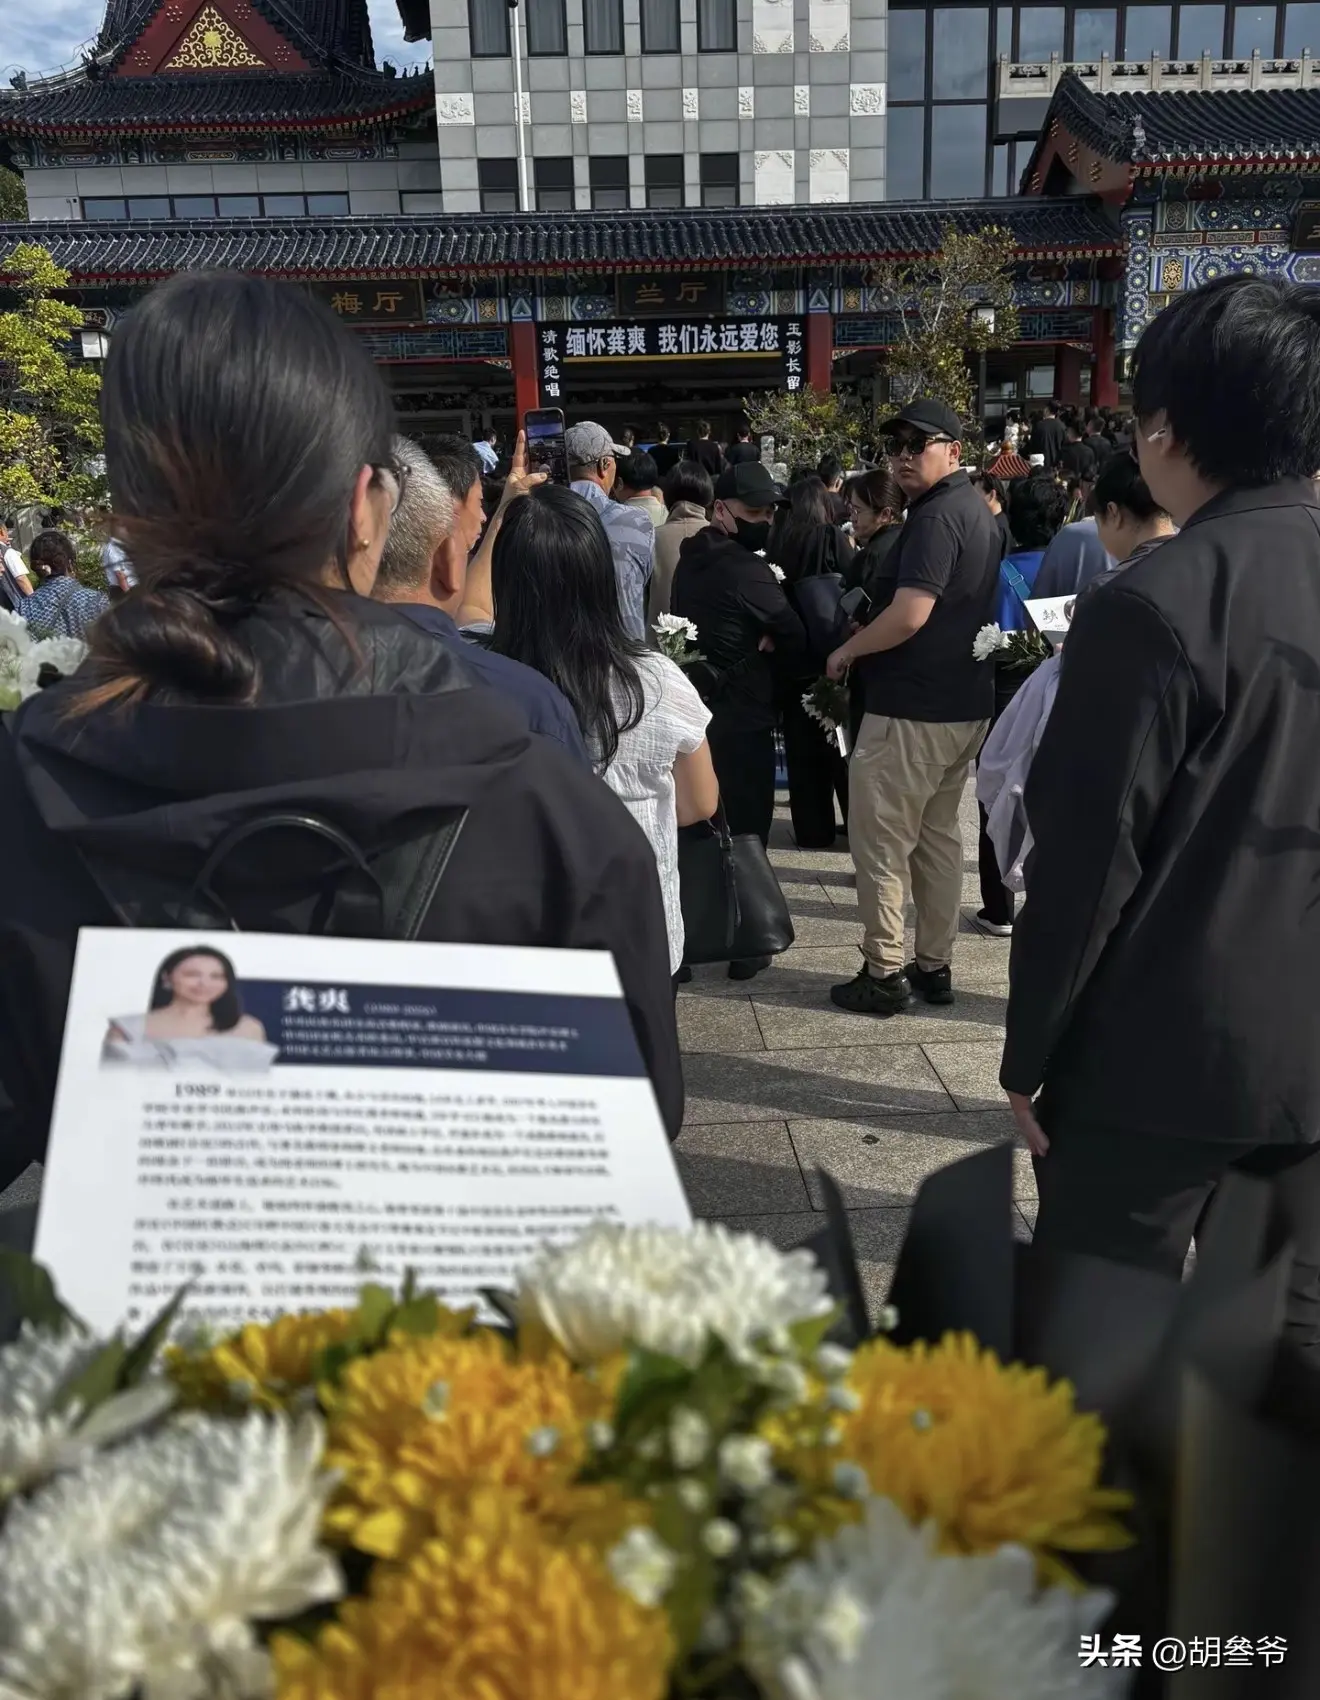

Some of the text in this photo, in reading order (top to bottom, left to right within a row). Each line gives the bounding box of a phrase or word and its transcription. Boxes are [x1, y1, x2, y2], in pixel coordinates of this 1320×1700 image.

[331, 291, 404, 315] 梅厅
[635, 282, 707, 303] 兰厅
[566, 322, 780, 357] 缅怀龚爽 我们永远爱您
[785, 322, 803, 390] 玉影长留
[542, 329, 560, 397] 清歌绝唱
